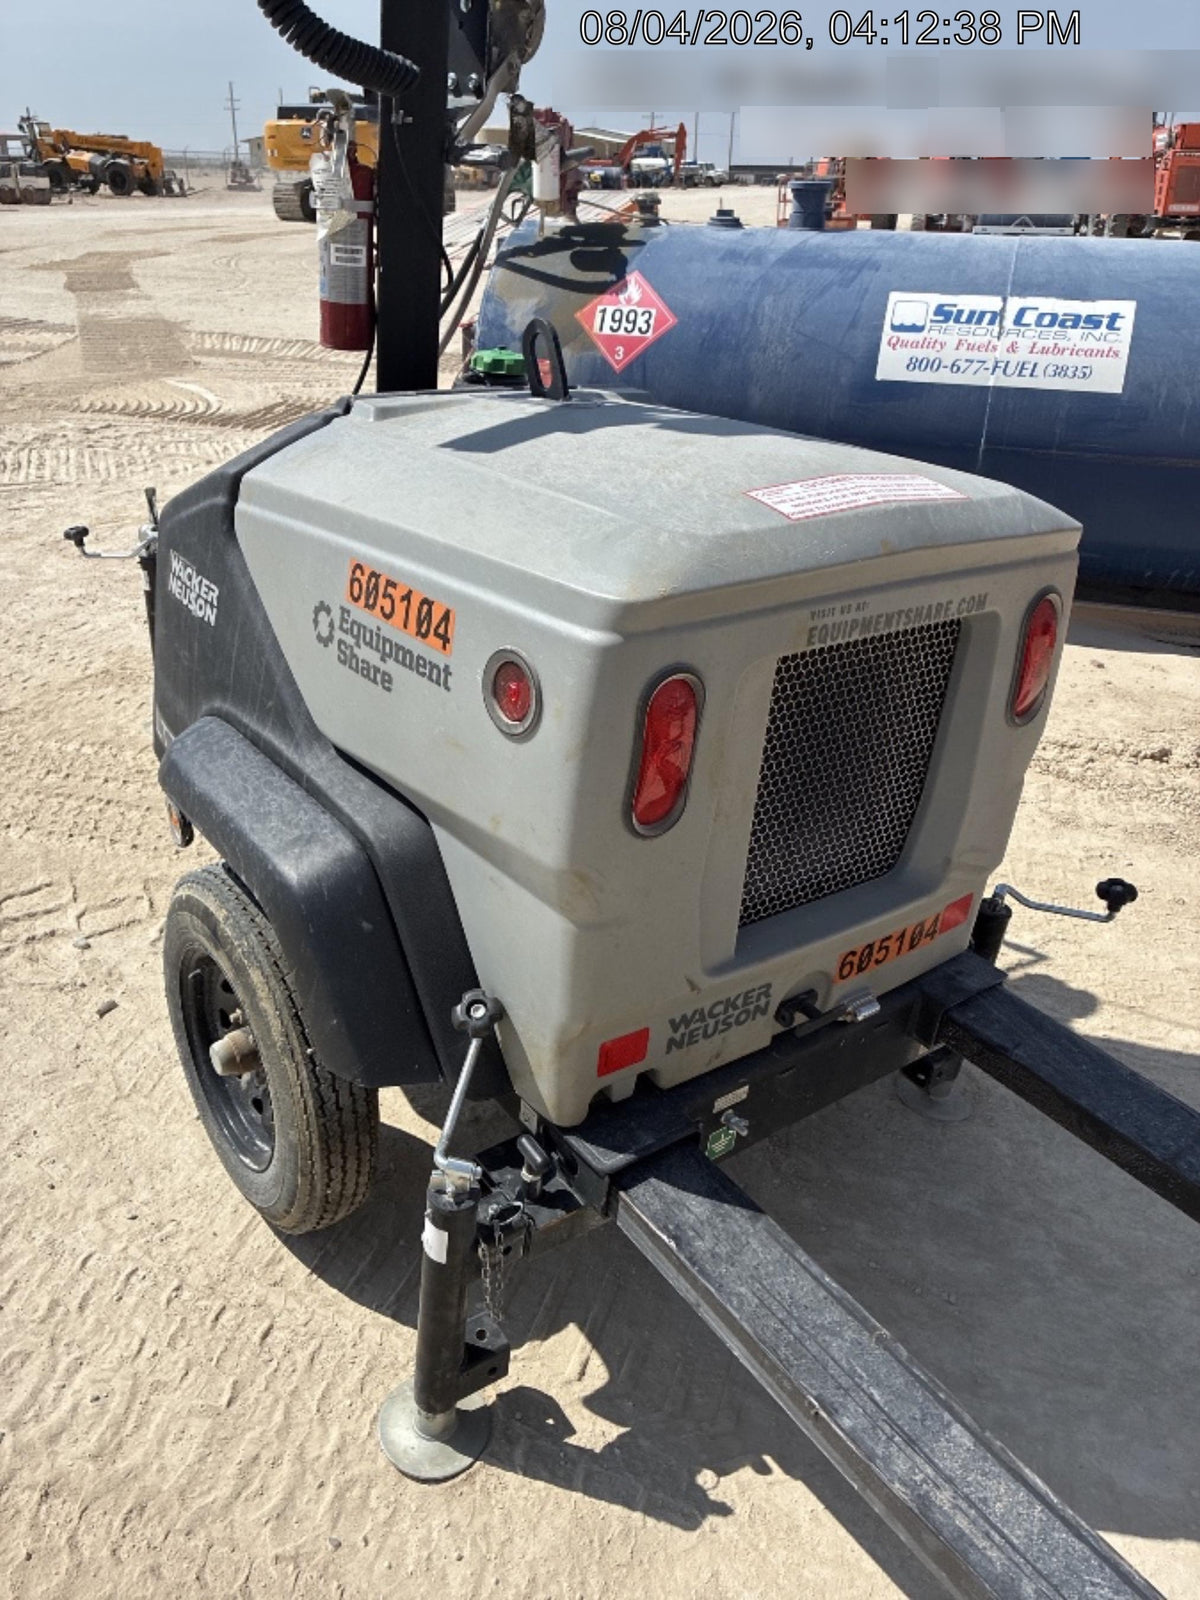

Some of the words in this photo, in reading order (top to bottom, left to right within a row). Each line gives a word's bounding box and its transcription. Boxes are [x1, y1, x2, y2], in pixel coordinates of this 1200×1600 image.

[598, 307, 653, 335] 1993
[928, 324, 1071, 342] RESOURCES,
[1080, 331, 1123, 344] INC.
[930, 303, 1000, 325] Sun
[1013, 306, 1125, 331] Coast
[614, 345, 625, 360] 3
[887, 335, 947, 353] Quality
[955, 338, 999, 355] Fuels
[1005, 339, 1020, 355] &
[1028, 340, 1121, 360] Lubricants
[906, 356, 1040, 379] 800-677-FUEL
[1042, 363, 1094, 381] (3835)
[168, 572, 218, 627] NEUSON
[169, 549, 220, 607] WACKER
[349, 562, 452, 652] 605104
[807, 593, 988, 645] EQUIPMENTSHARE.COM
[336, 637, 394, 692] Share
[338, 604, 453, 693] Equipment
[838, 913, 941, 981] 605104
[665, 1001, 771, 1055] NEUSON
[668, 982, 774, 1035] WACKER
